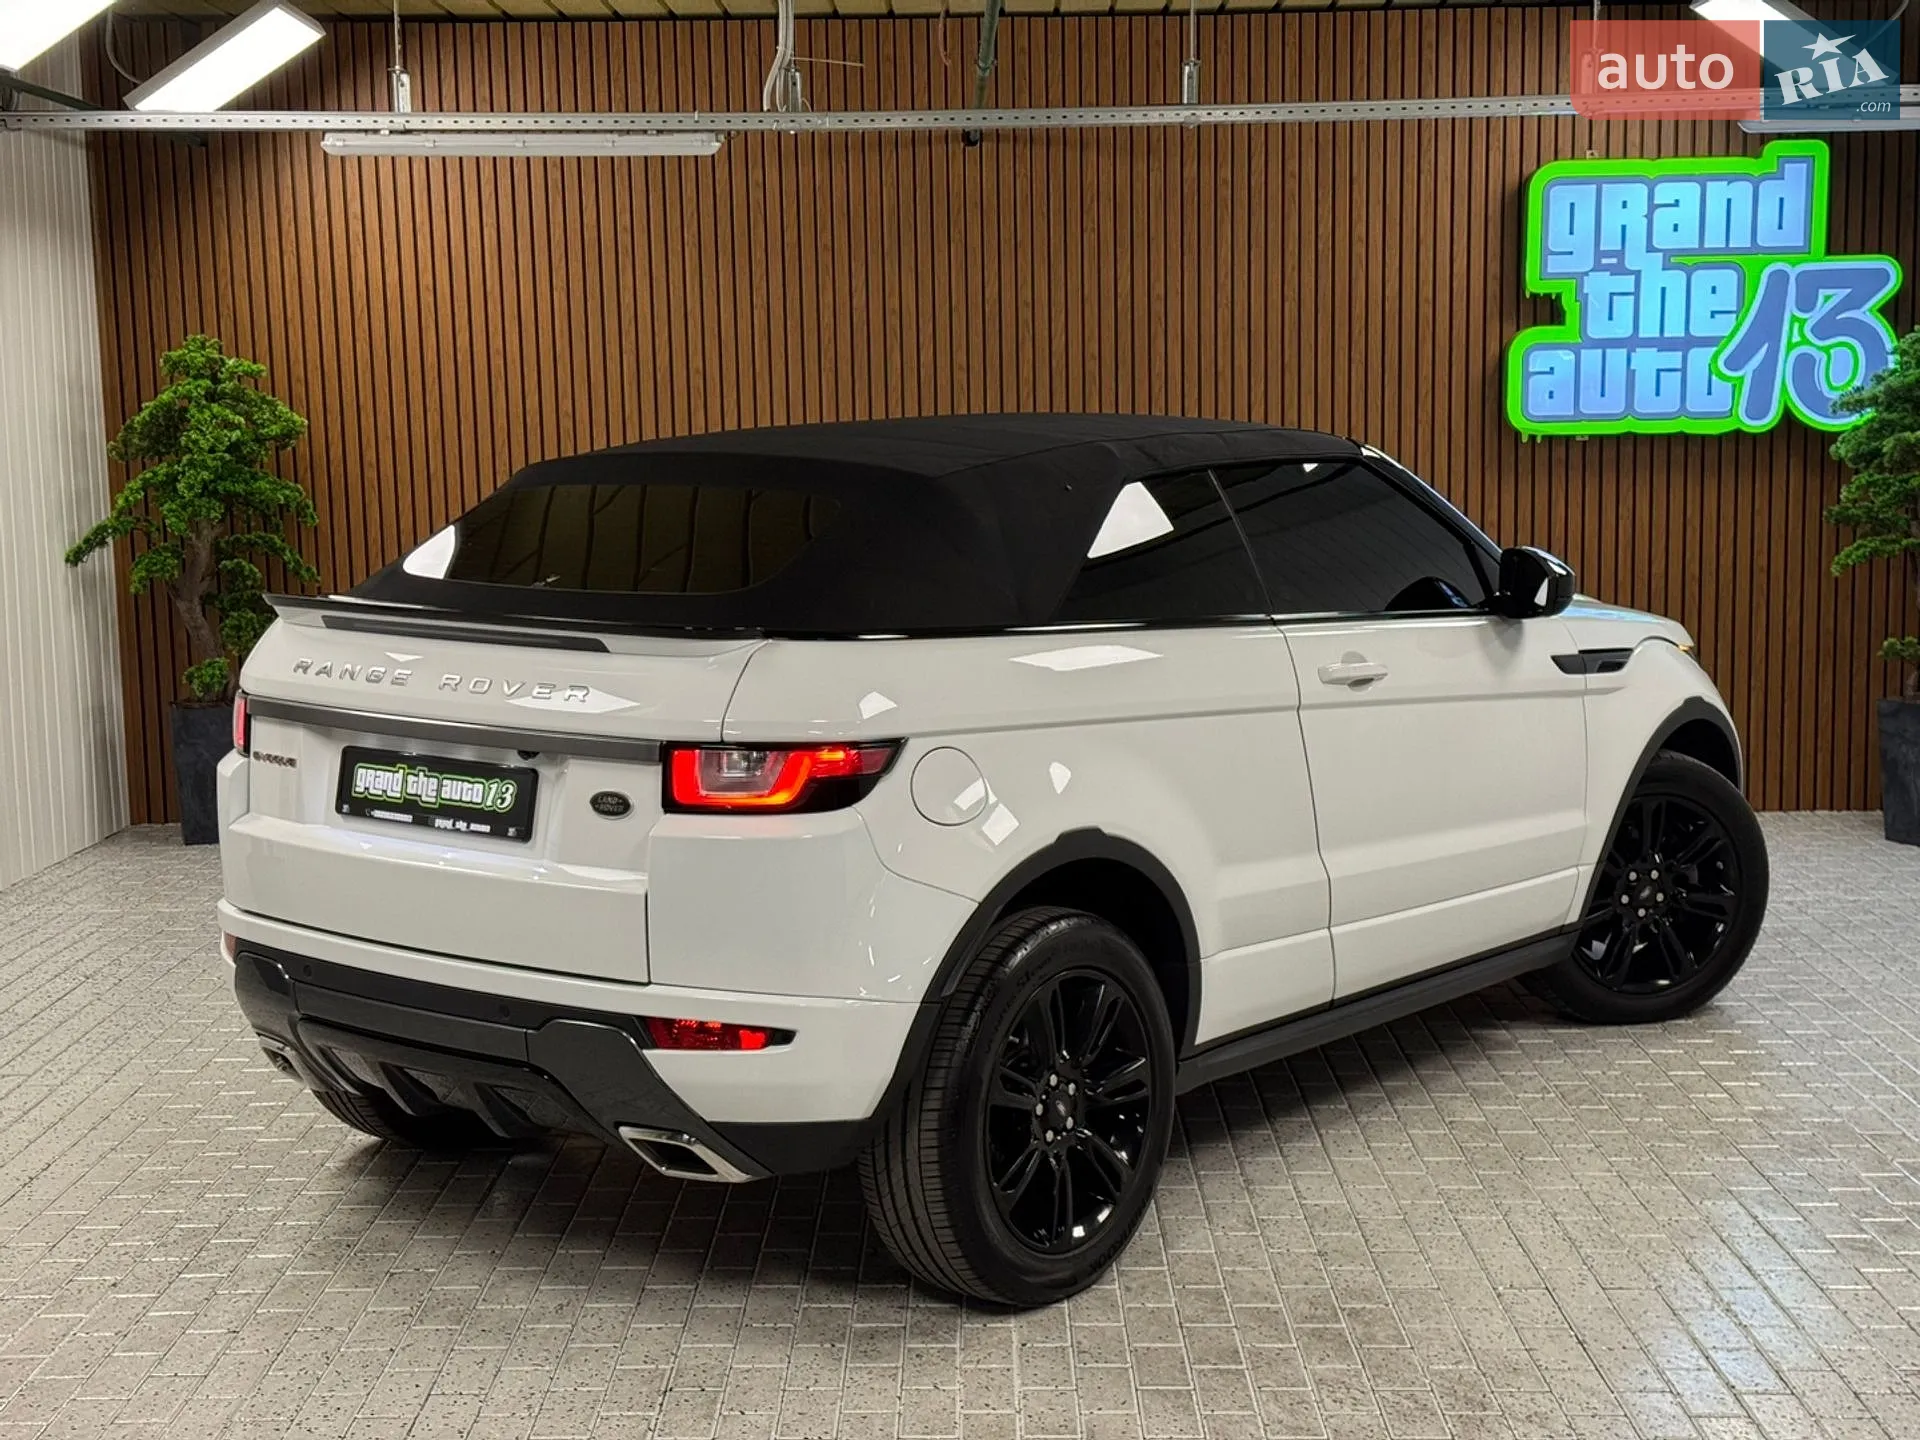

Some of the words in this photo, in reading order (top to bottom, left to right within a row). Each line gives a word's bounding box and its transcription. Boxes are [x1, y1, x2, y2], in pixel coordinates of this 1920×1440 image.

[1583, 253, 1739, 339] the
[1717, 262, 1898, 426] 13
[1527, 347, 1733, 416] auto
[293, 658, 412, 686] RANGE
[439, 674, 592, 703] ROVER
[441, 777, 484, 804] auto
[485, 780, 514, 809] 13
